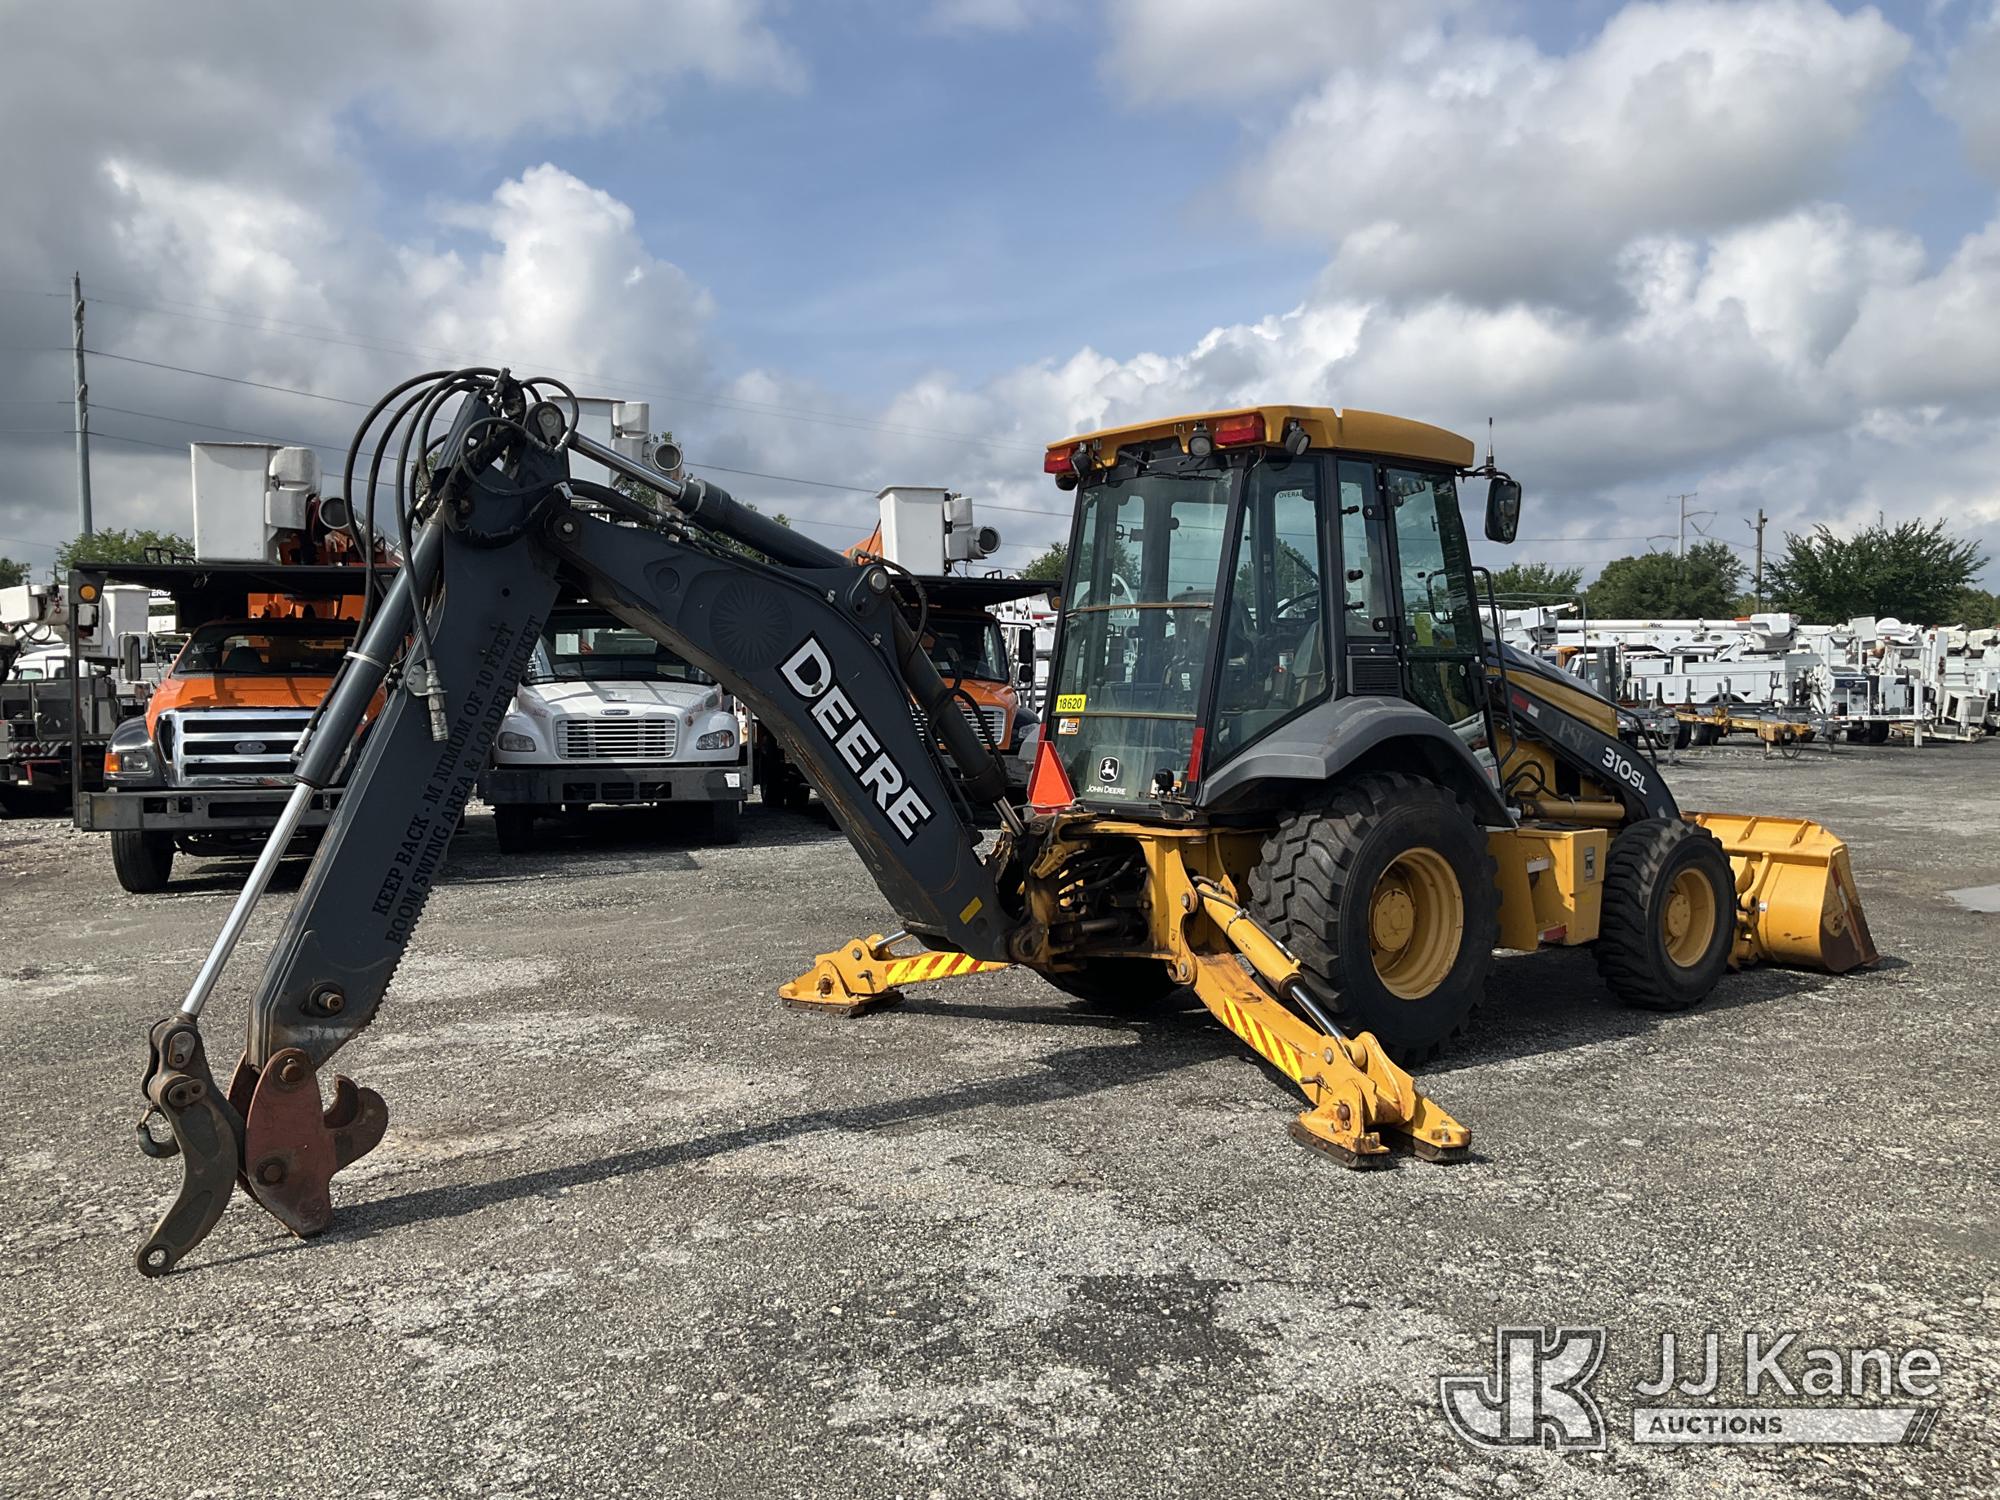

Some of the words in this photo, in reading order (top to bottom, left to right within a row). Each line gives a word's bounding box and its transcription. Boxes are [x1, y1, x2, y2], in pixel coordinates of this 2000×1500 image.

[484, 621, 515, 669] FEET
[463, 690, 484, 716] OF
[475, 668, 494, 692] 10
[1059, 698, 1083, 709] 18620
[779, 635, 933, 841] DEERE
[385, 887, 423, 944] BOOM
[412, 825, 451, 887] SWING
[441, 776, 474, 825] AREA
[476, 685, 514, 755] LOADER
[503, 614, 543, 682] BUCKET
[1086, 784, 1104, 793] JOHN
[1104, 785, 1127, 795] DEERE
[1601, 746, 1648, 795] 310SL
[394, 814, 430, 866] BACK
[371, 867, 404, 916] KEEP
